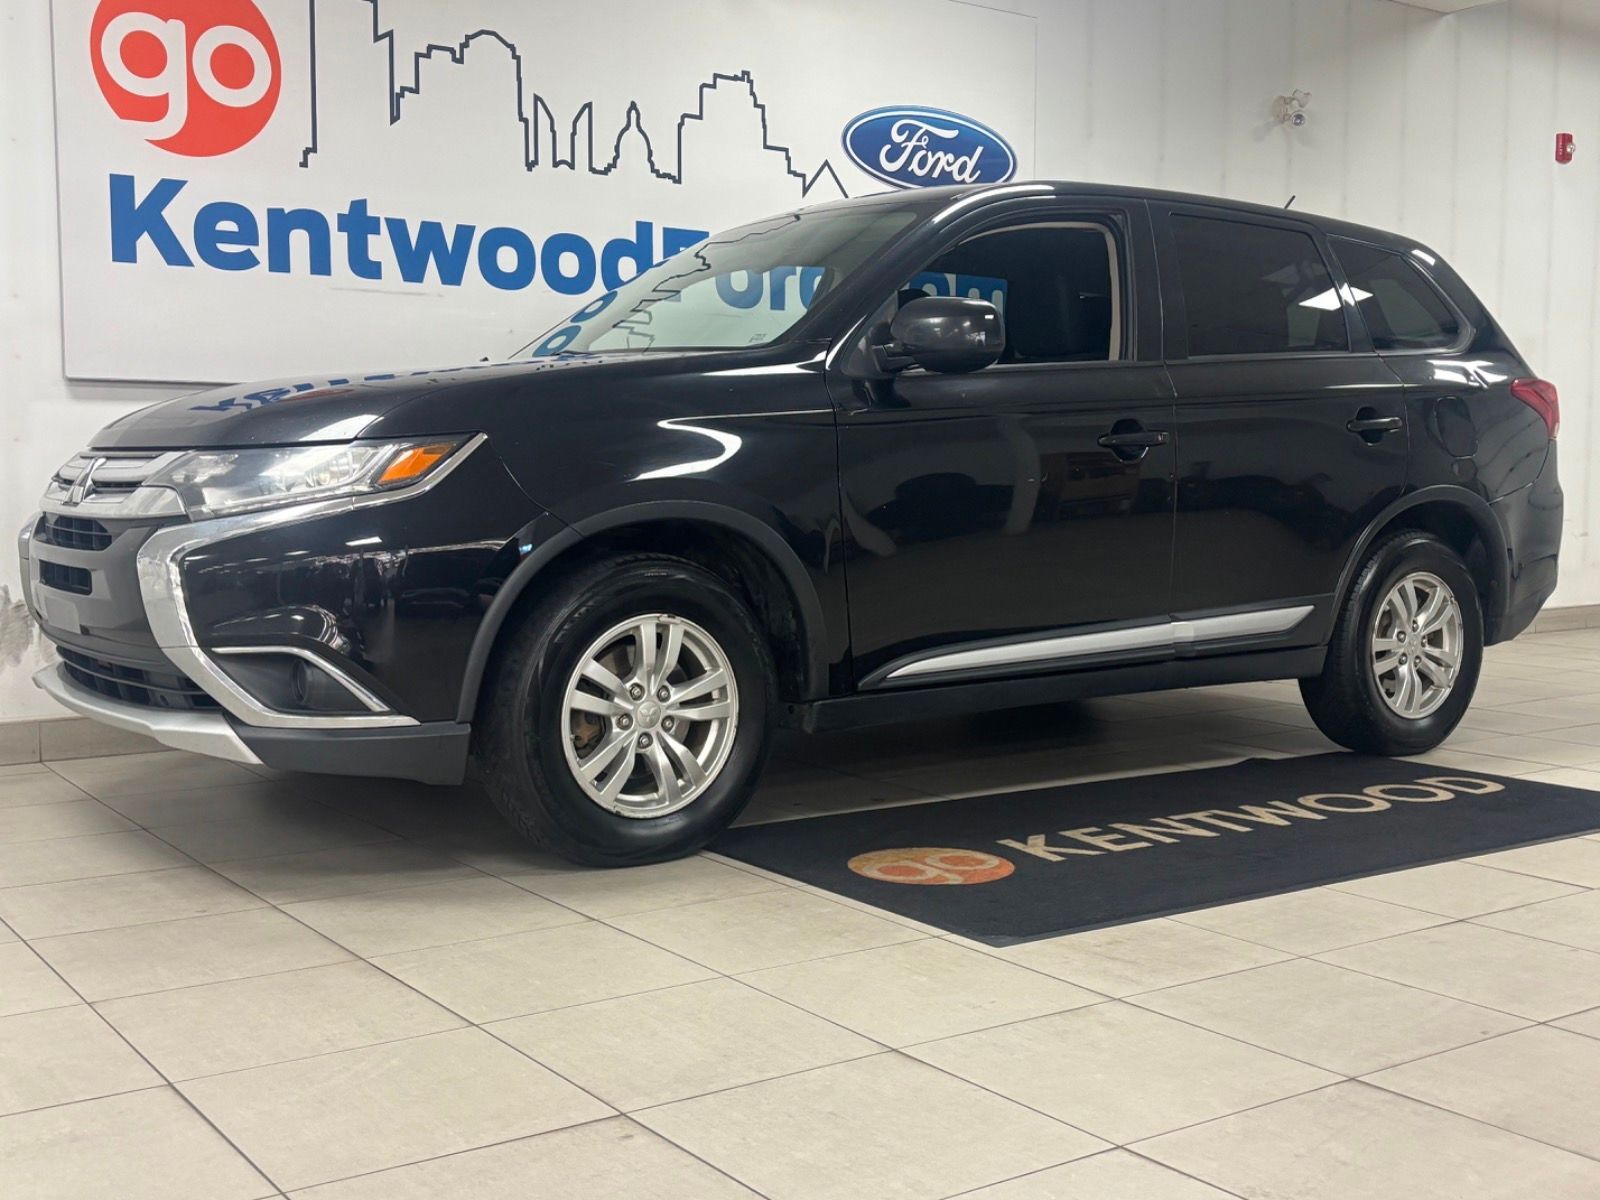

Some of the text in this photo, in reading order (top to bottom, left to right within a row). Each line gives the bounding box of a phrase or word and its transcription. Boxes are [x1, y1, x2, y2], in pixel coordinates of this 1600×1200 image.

[101, 11, 272, 141] go
[879, 118, 985, 184] Ford
[999, 776, 1506, 862] KENTWOOD
[863, 852, 1000, 885] go
